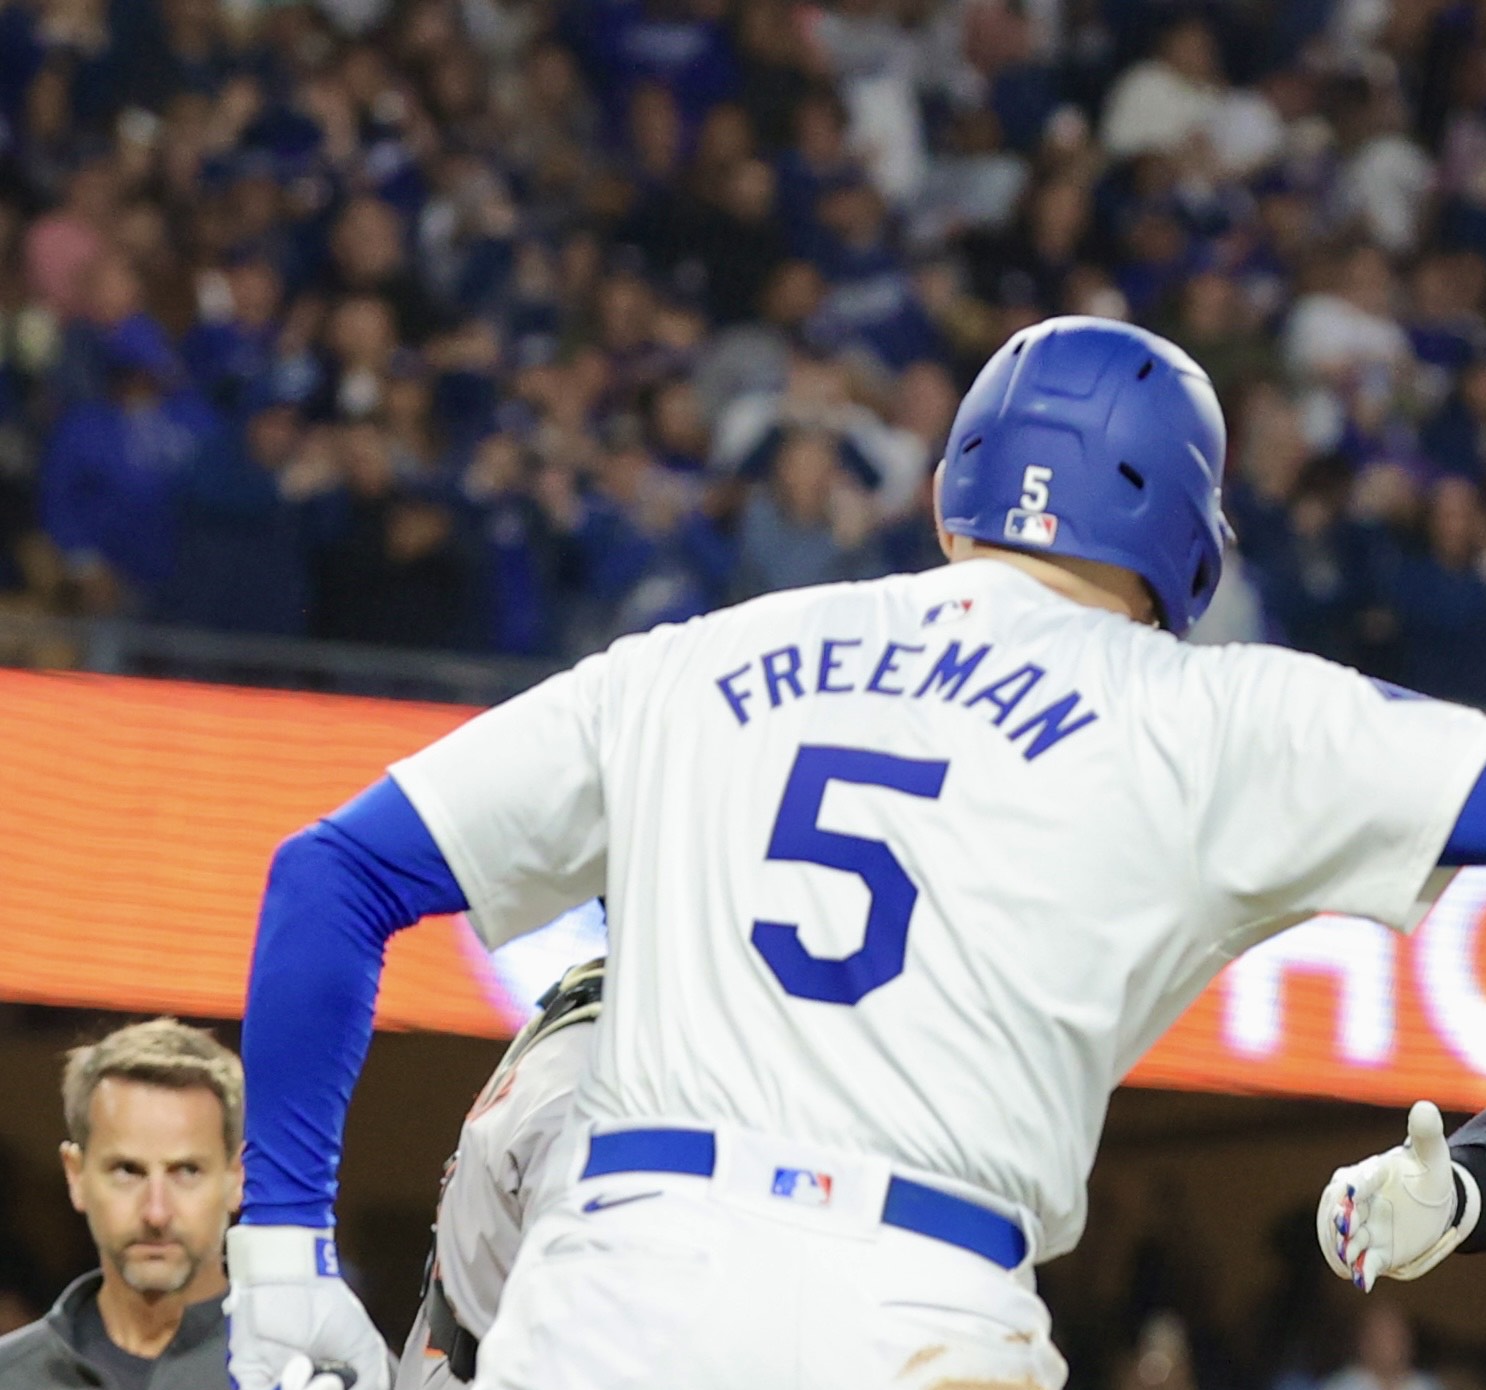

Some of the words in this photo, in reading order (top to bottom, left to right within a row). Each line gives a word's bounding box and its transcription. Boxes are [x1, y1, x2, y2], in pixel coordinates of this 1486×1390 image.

[1020, 464, 1053, 512] 5
[715, 638, 1099, 762] FREEMAN
[750, 742, 950, 1007] 5
